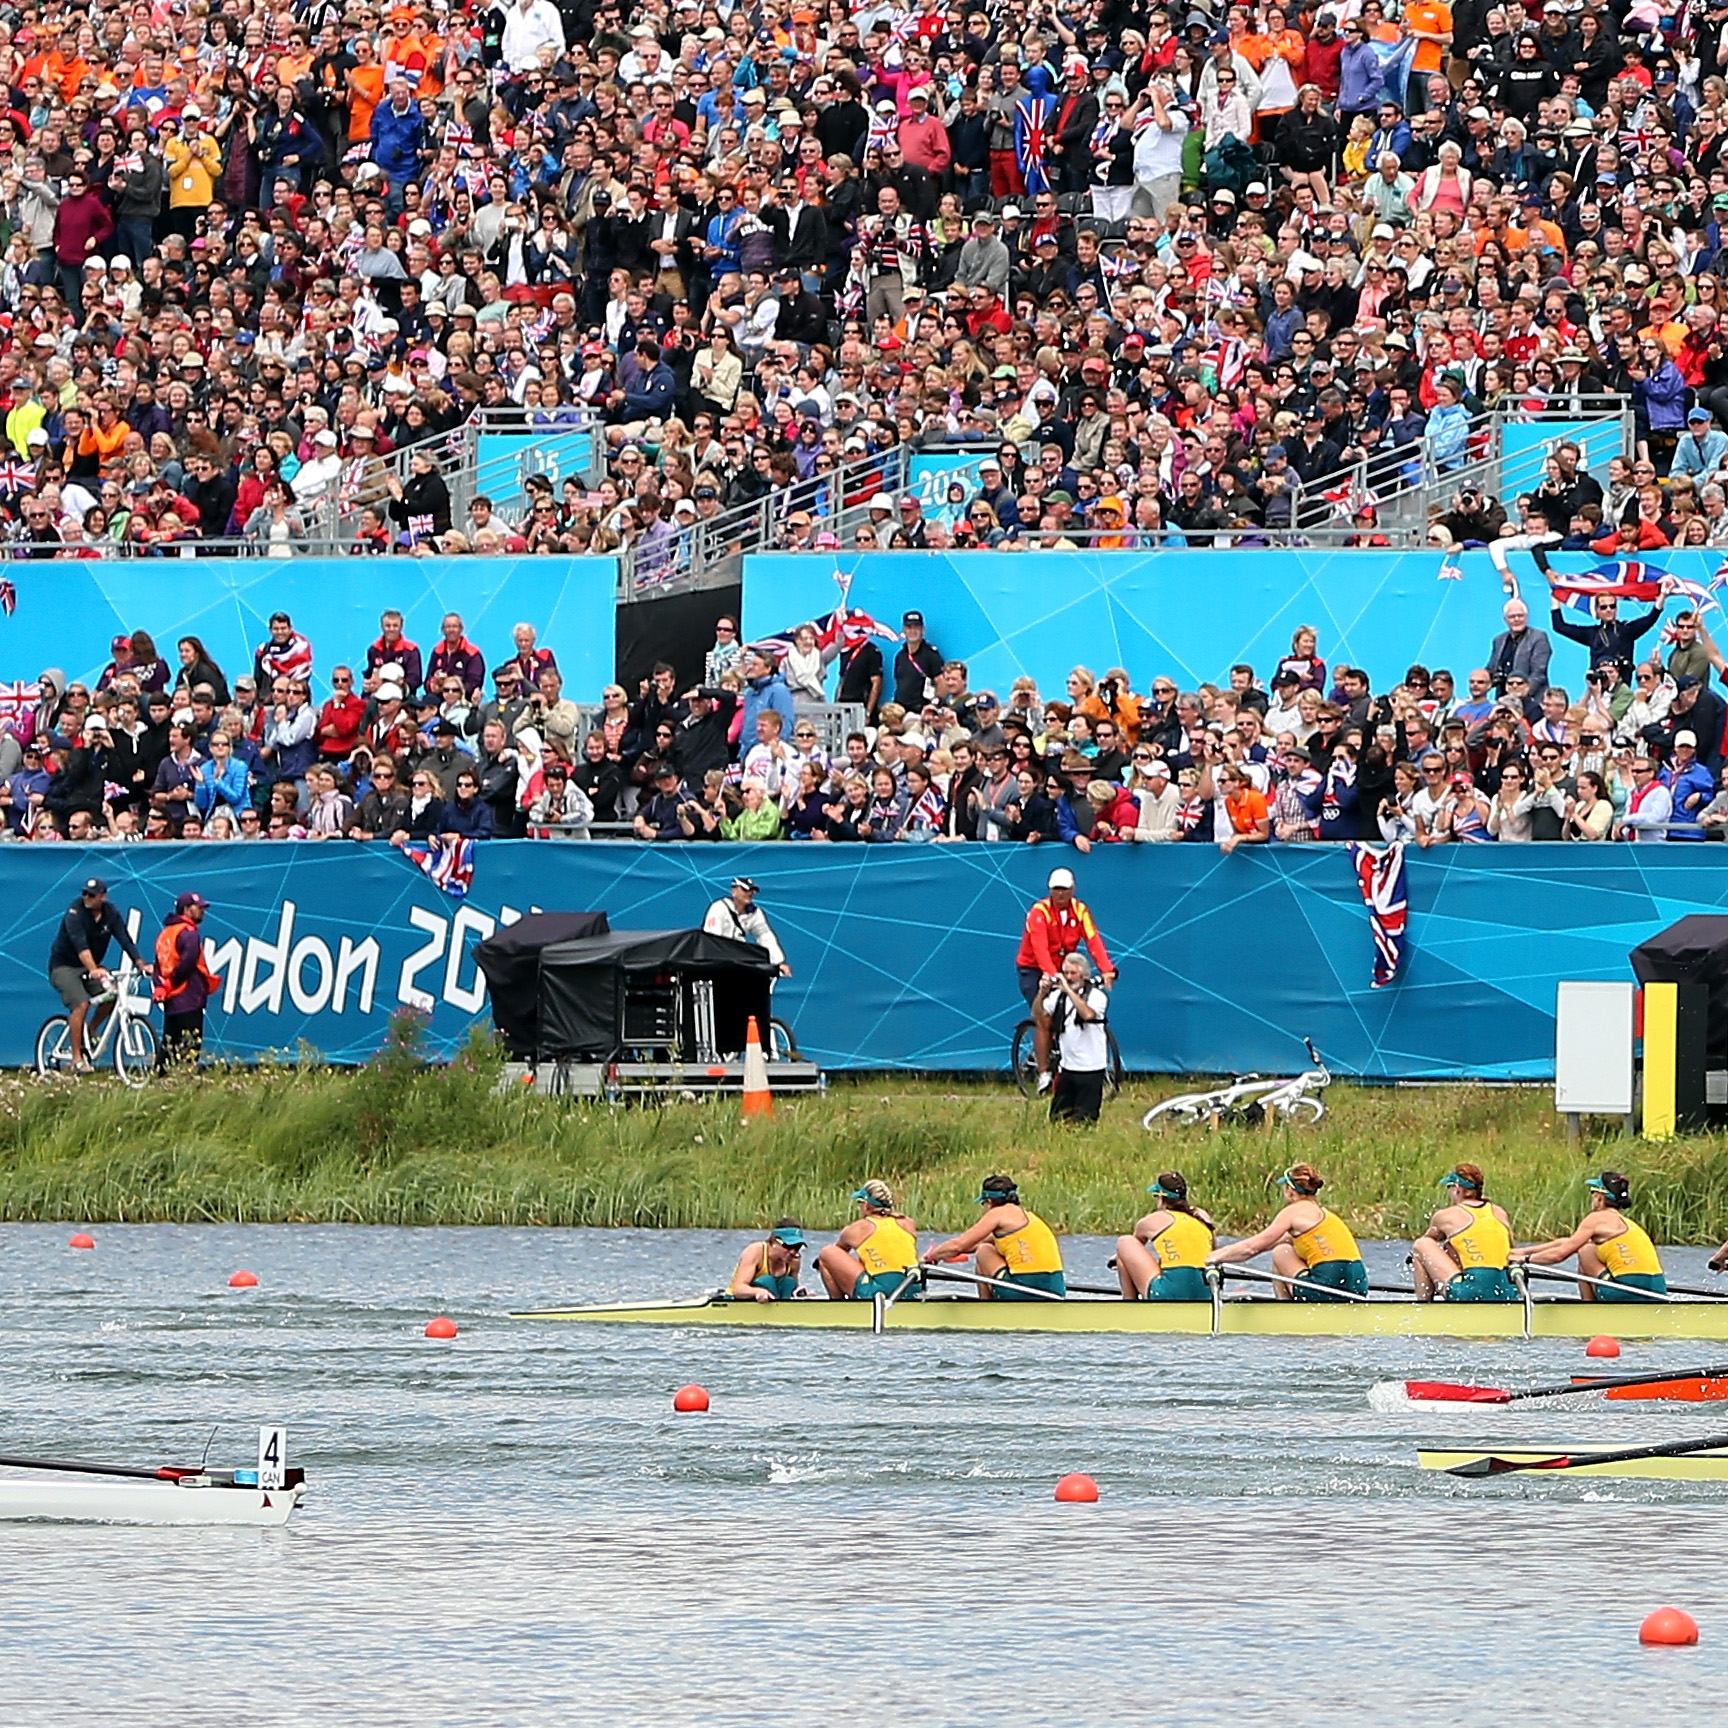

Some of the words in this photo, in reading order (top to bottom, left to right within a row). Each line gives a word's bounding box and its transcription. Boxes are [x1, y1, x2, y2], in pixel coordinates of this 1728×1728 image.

[119, 900, 380, 1015] Lndon
[865, 1248, 886, 1268] AUS
[1163, 1239, 1180, 1261] AUS
[1463, 1238, 1484, 1262] AUS
[1616, 1242, 1637, 1266] AUS
[263, 1431, 280, 1468] 4
[261, 1472, 280, 1484] CAN
